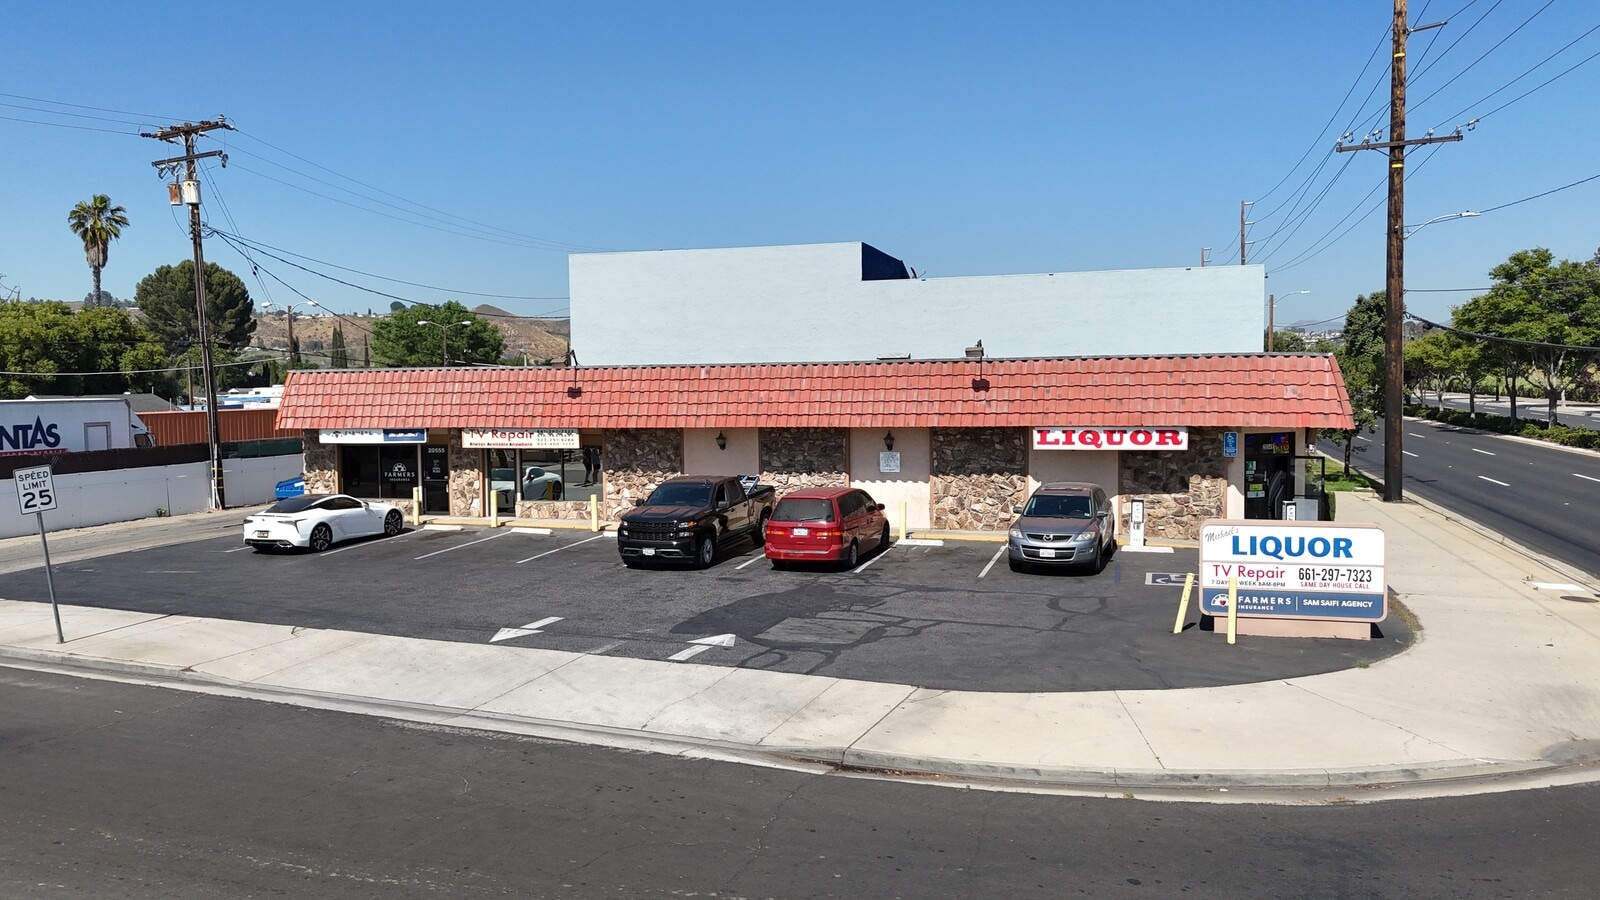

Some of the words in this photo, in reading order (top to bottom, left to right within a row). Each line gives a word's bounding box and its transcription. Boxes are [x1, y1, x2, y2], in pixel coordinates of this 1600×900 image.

[469, 429, 486, 438] TV
[492, 429, 534, 441] Repair
[1036, 430, 1183, 448] LIQUOR
[18, 471, 49, 482] SPEED
[22, 480, 47, 490] LIMIT
[22, 489, 52, 509] 25
[1205, 526, 1238, 542] Michael's
[1232, 536, 1353, 560] LIQUOR
[1213, 564, 1232, 577] TV
[1238, 565, 1286, 581] Repair
[1298, 568, 1372, 582] 661-297-7323
[1238, 596, 1292, 605] FARMERS
